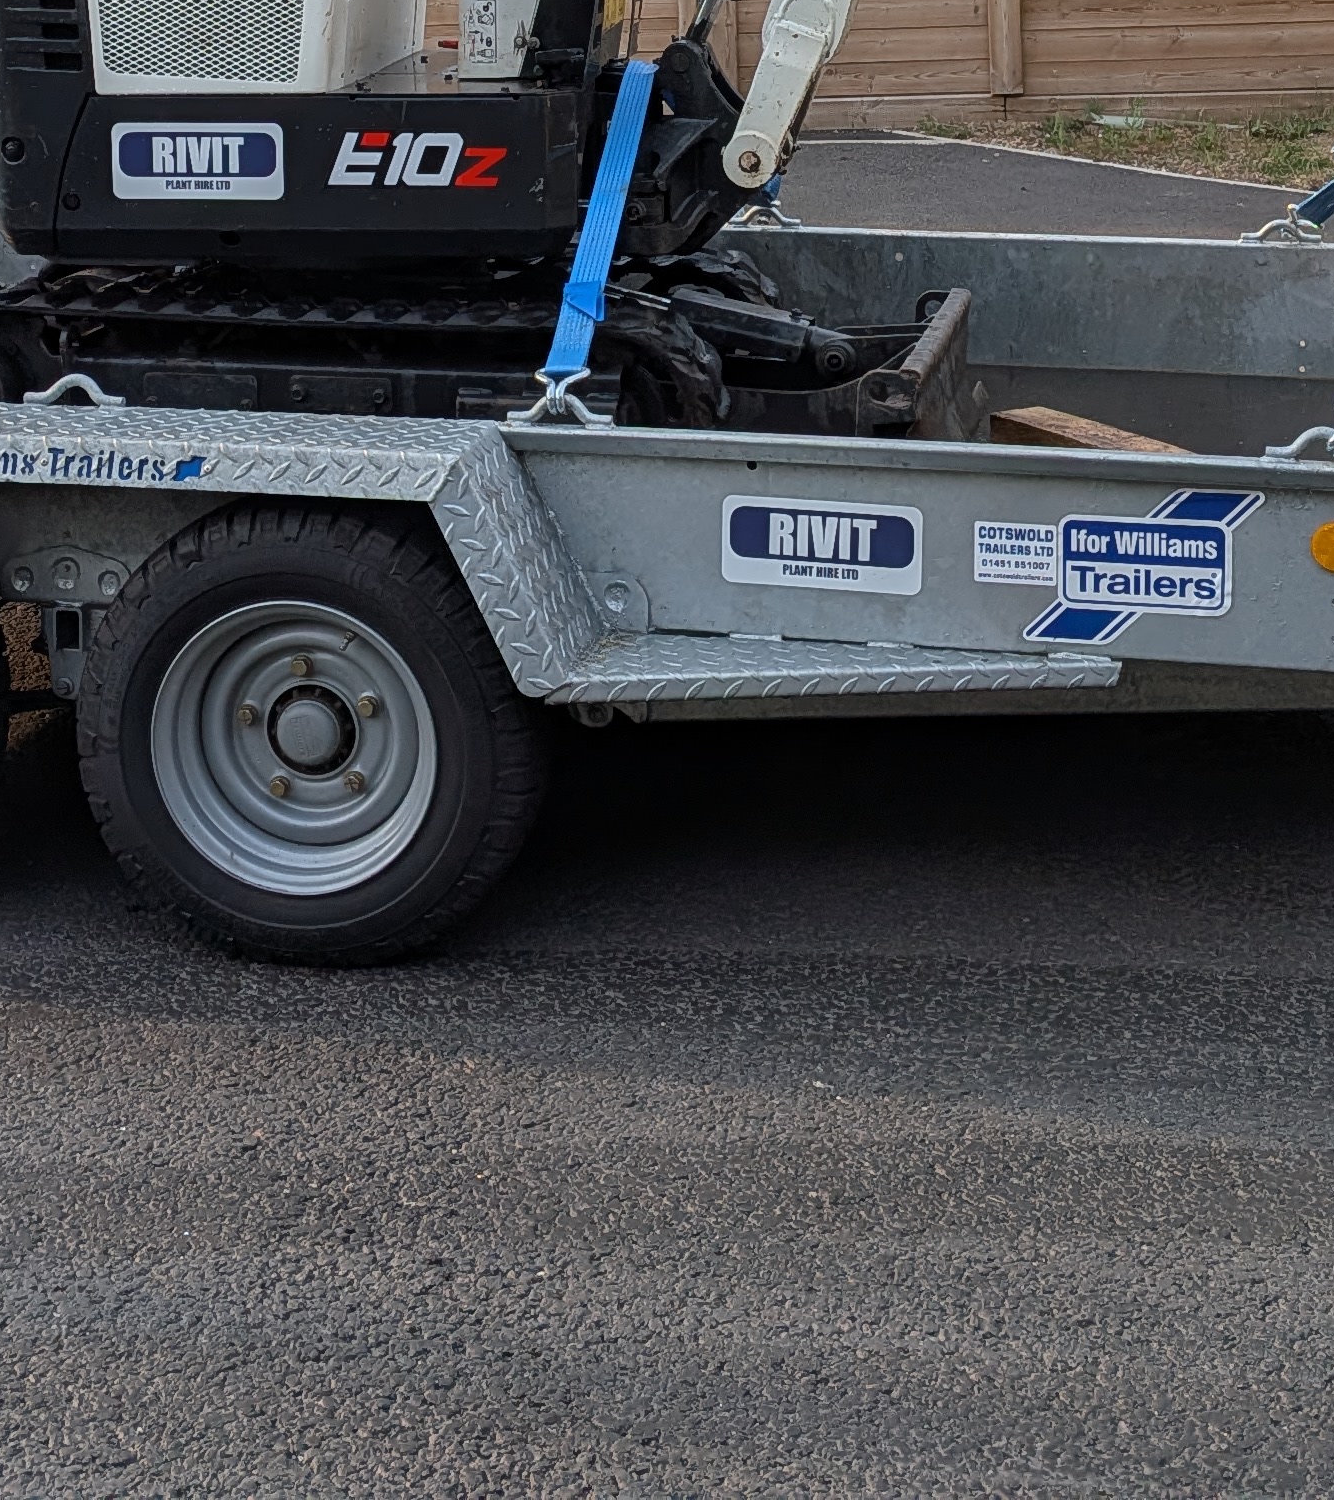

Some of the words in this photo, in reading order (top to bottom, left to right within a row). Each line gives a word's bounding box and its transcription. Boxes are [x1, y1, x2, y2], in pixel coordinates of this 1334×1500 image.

[152, 136, 244, 174] RIVIT
[165, 180, 192, 190] PLANT
[194, 180, 214, 190] HIRE
[216, 180, 231, 190] LTD
[47, 447, 166, 482] Trailers
[769, 512, 877, 562] RIVIT
[978, 526, 1054, 543] COTSWOLD
[1070, 528, 1110, 554] Ifor
[1114, 530, 1218, 560] Williams
[978, 542, 1031, 556] TRAILERS
[1034, 545, 1054, 557] LTD
[782, 563, 814, 577] PLANT
[816, 566, 840, 579] HIRE
[841, 567, 859, 580] LTD
[981, 558, 1011, 568] 01451
[1071, 565, 1217, 600] Trailers
